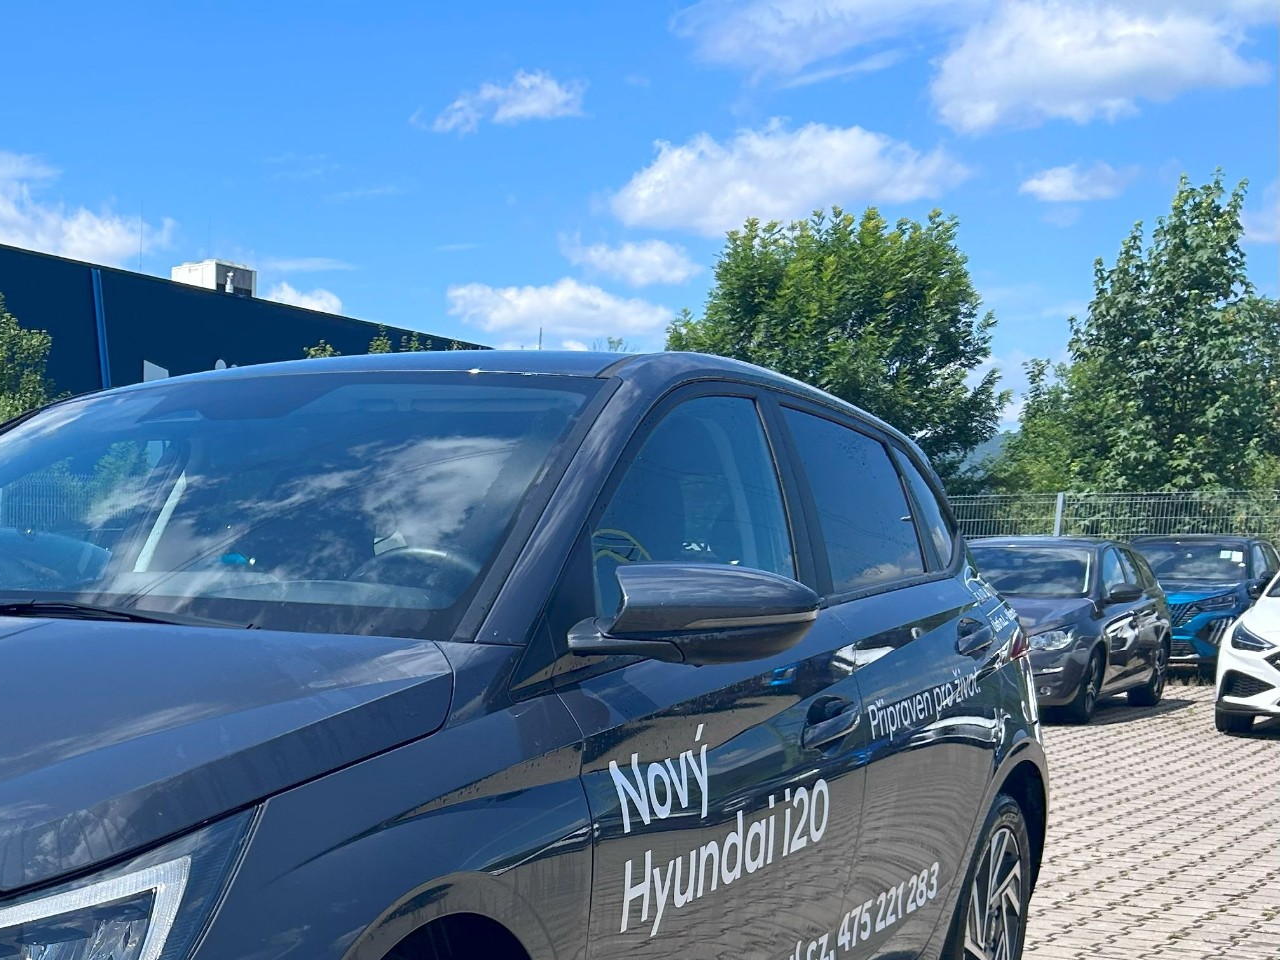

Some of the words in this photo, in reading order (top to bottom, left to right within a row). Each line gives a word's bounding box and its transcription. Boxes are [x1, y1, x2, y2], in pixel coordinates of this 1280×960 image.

[867, 691, 933, 741] Připraven
[933, 682, 953, 720] pro
[609, 724, 708, 833] Nový
[620, 795, 775, 937] Hyundai
[782, 779, 830, 857] i20
[837, 899, 874, 952] 475
[875, 882, 904, 934] 221
[906, 862, 940, 914] 283
